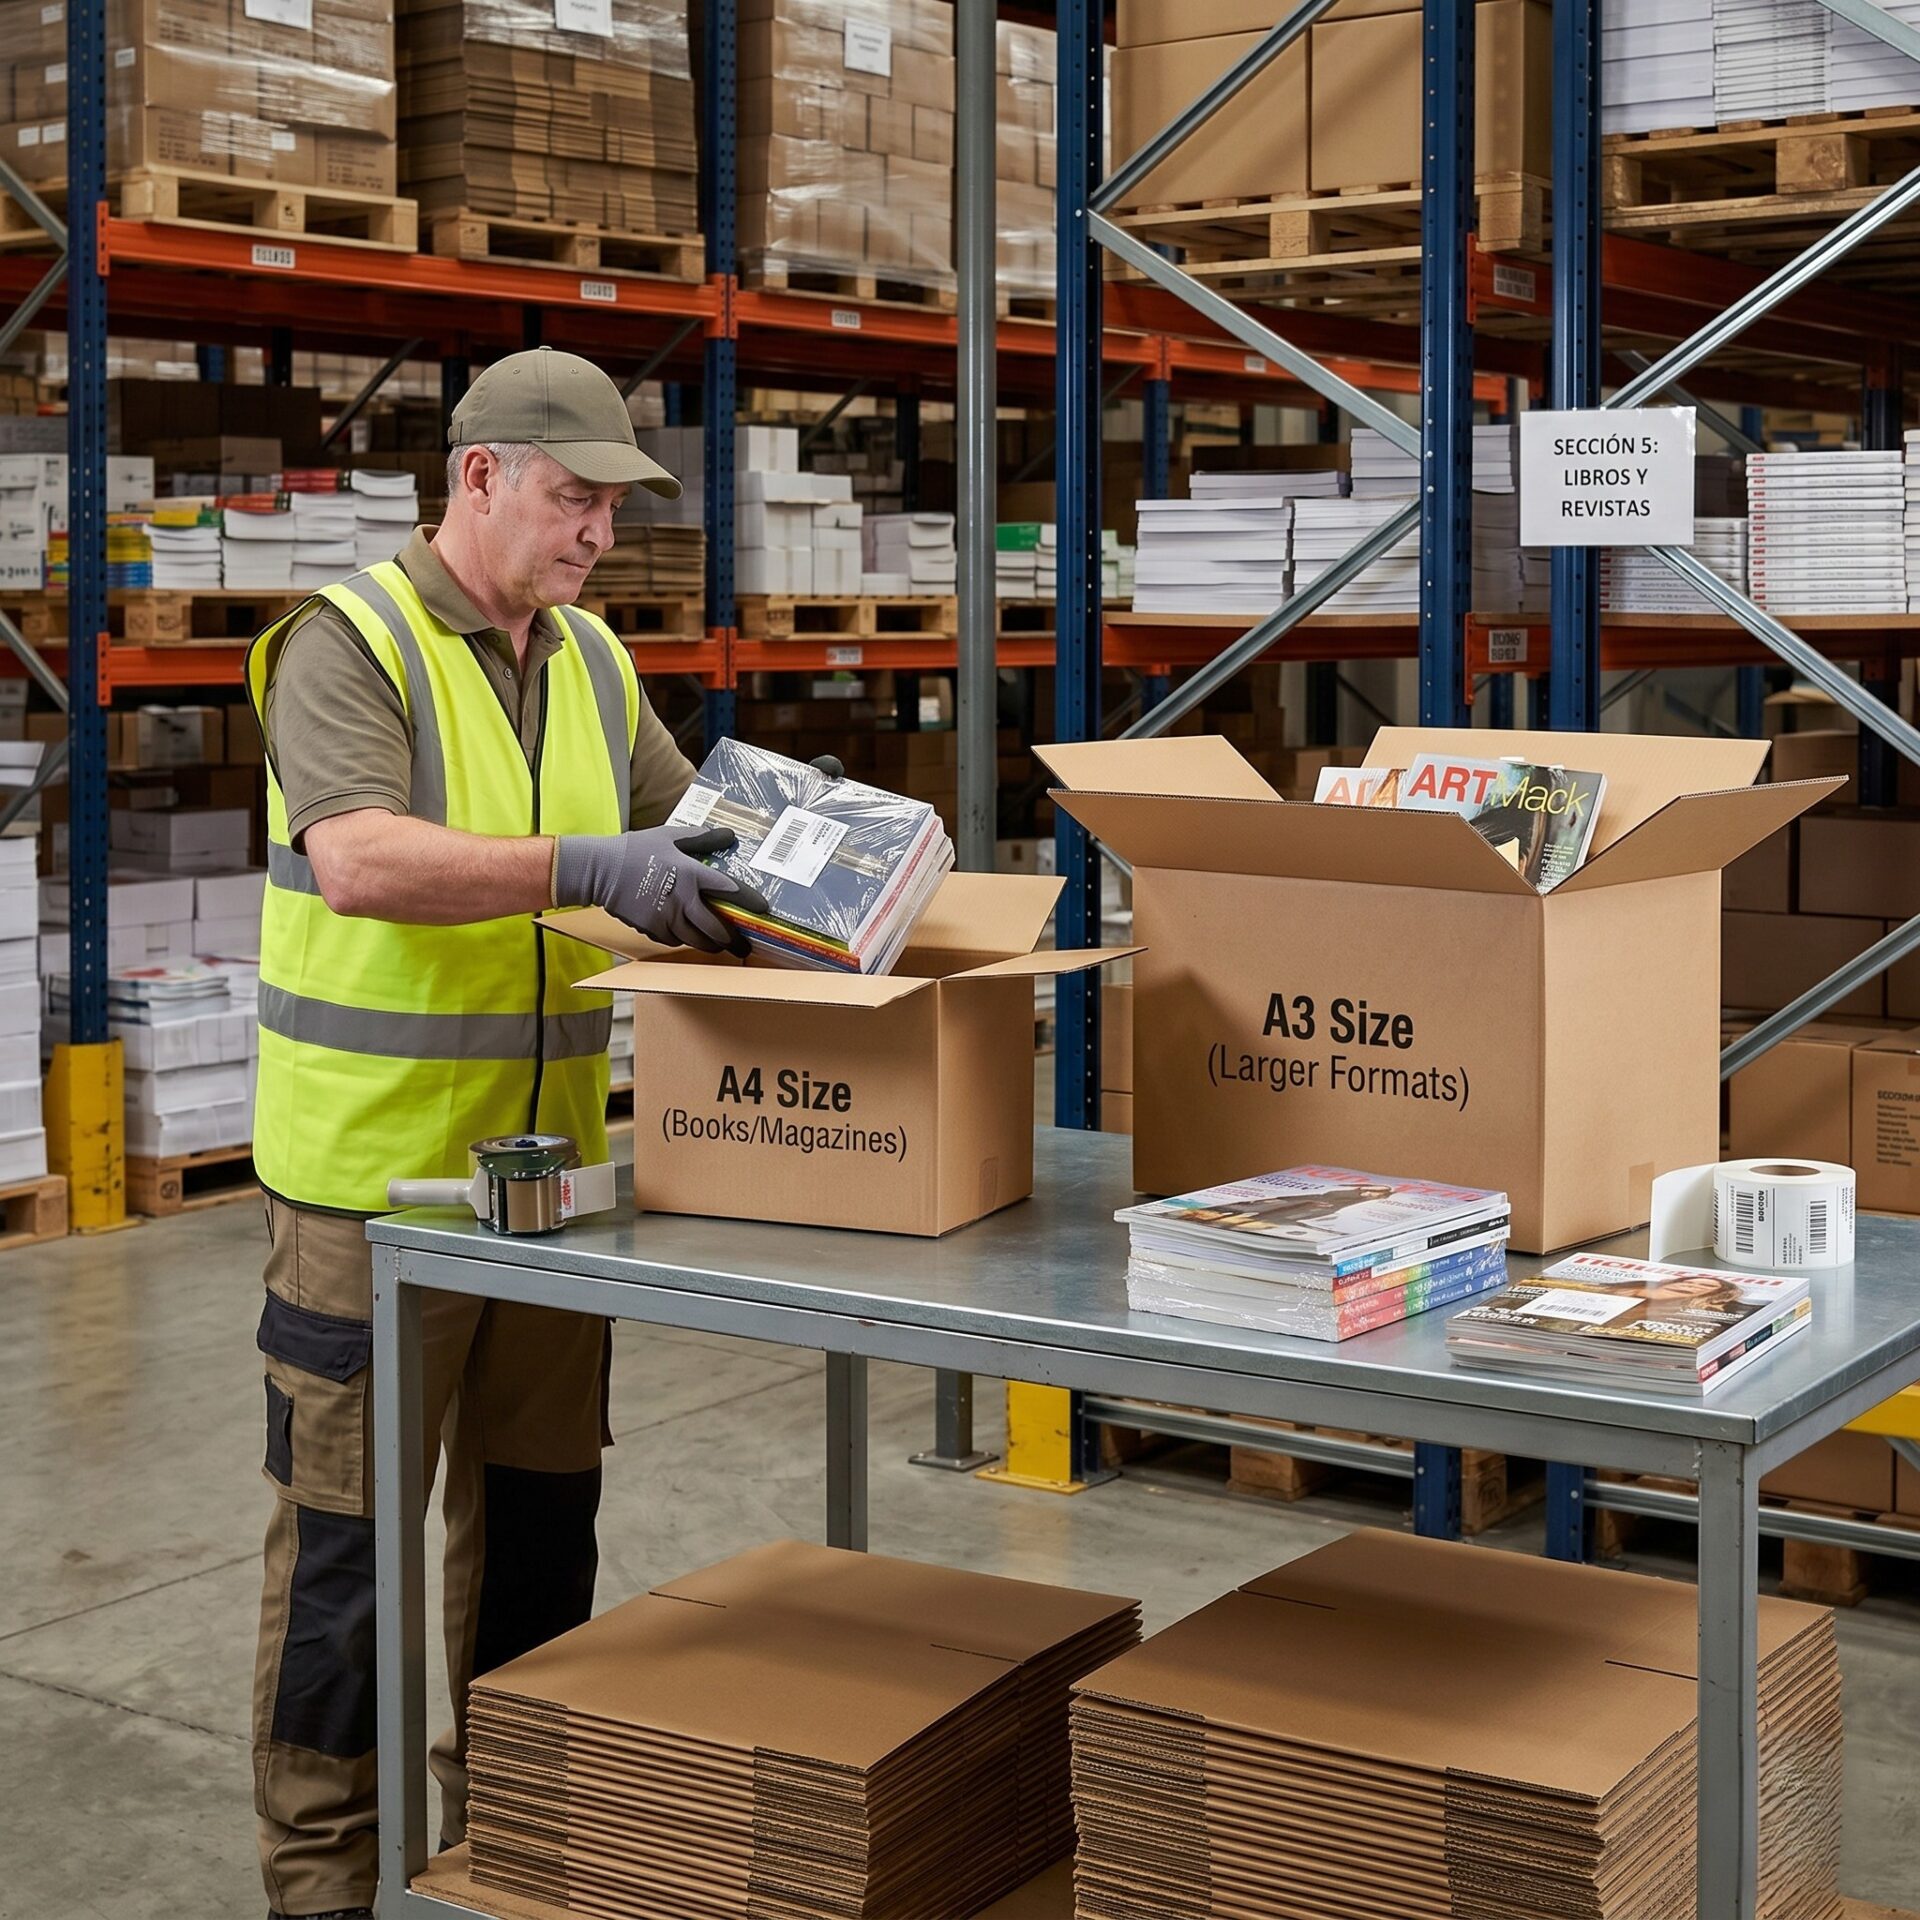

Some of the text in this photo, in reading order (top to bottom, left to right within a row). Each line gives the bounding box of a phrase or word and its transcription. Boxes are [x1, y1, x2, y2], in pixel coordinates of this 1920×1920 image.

[1553, 433, 1659, 456] SECCIÓN 5:
[1564, 468, 1649, 487] LIBROS Y
[1561, 499, 1651, 518] REVISTAS
[1407, 763, 1499, 806] ART
[1262, 992, 1414, 1050] A3 Size
[716, 1065, 852, 1113] A4 Size
[1208, 1042, 1470, 1113] (Larger Formats)
[662, 1107, 908, 1164] (Books/Magazines)
